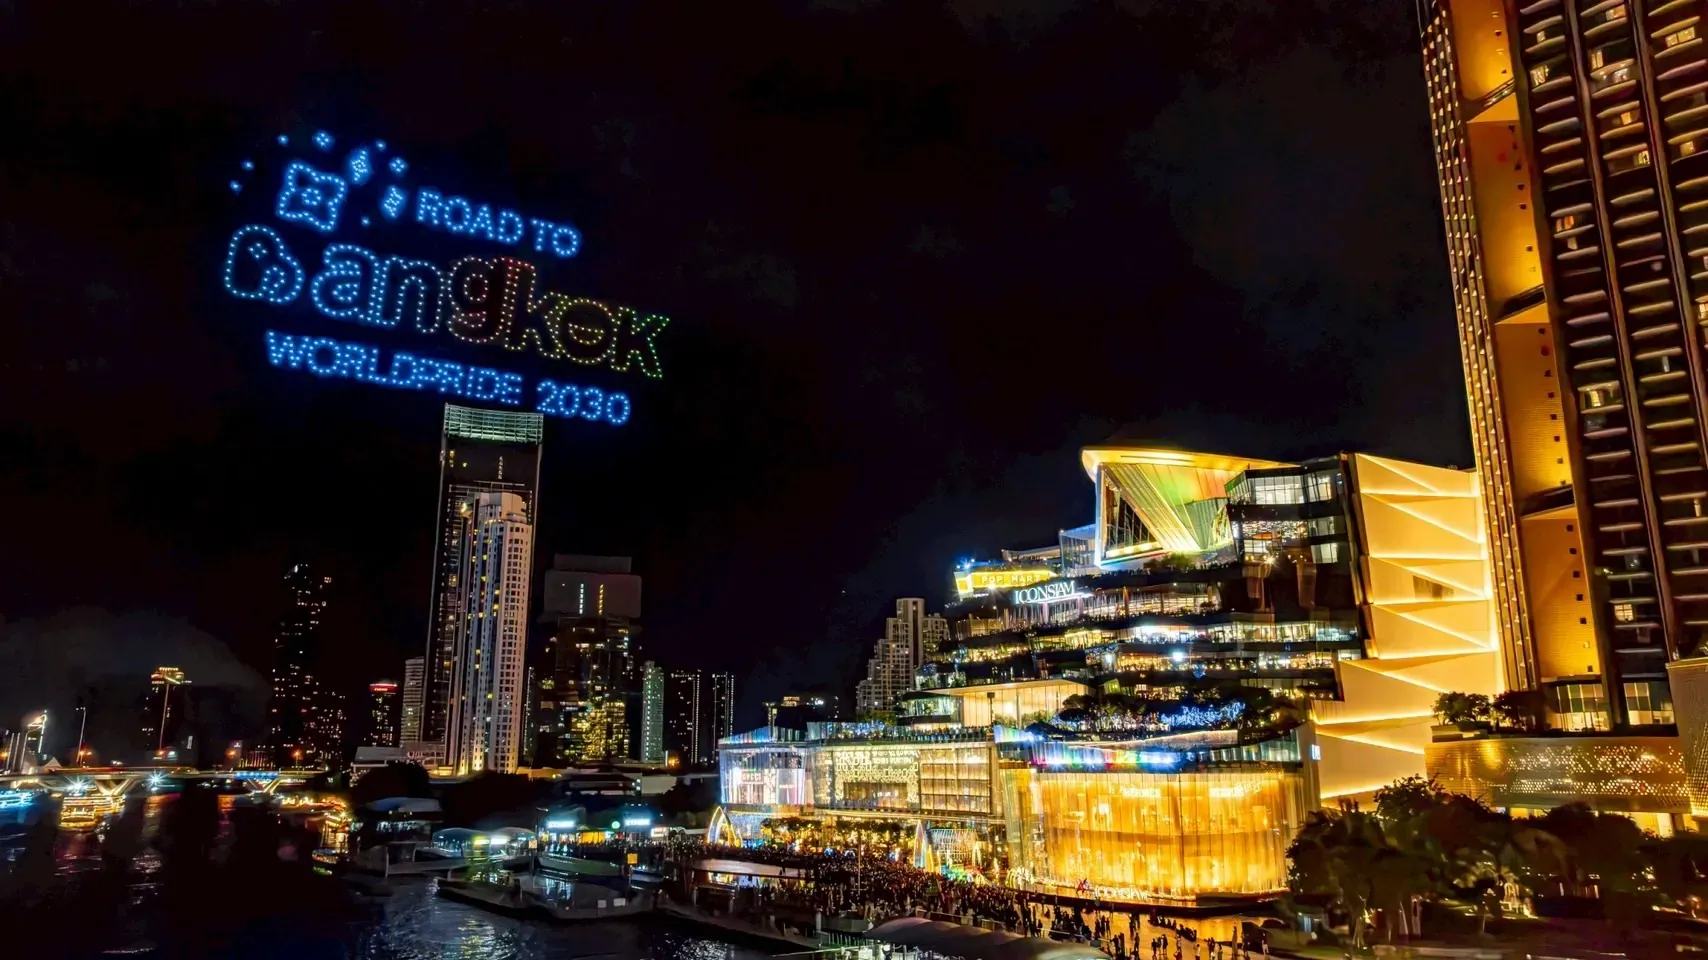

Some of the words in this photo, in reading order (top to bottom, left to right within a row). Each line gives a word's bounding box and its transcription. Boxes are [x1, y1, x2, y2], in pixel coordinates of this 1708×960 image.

[417, 189, 524, 243] ROAD
[530, 217, 581, 257] TO
[266, 330, 523, 406] WORLDPRIDE
[535, 380, 631, 424] 2030
[981, 575, 1004, 585] POP
[1011, 574, 1041, 583] MART
[1014, 581, 1075, 605] ICONSIAM
